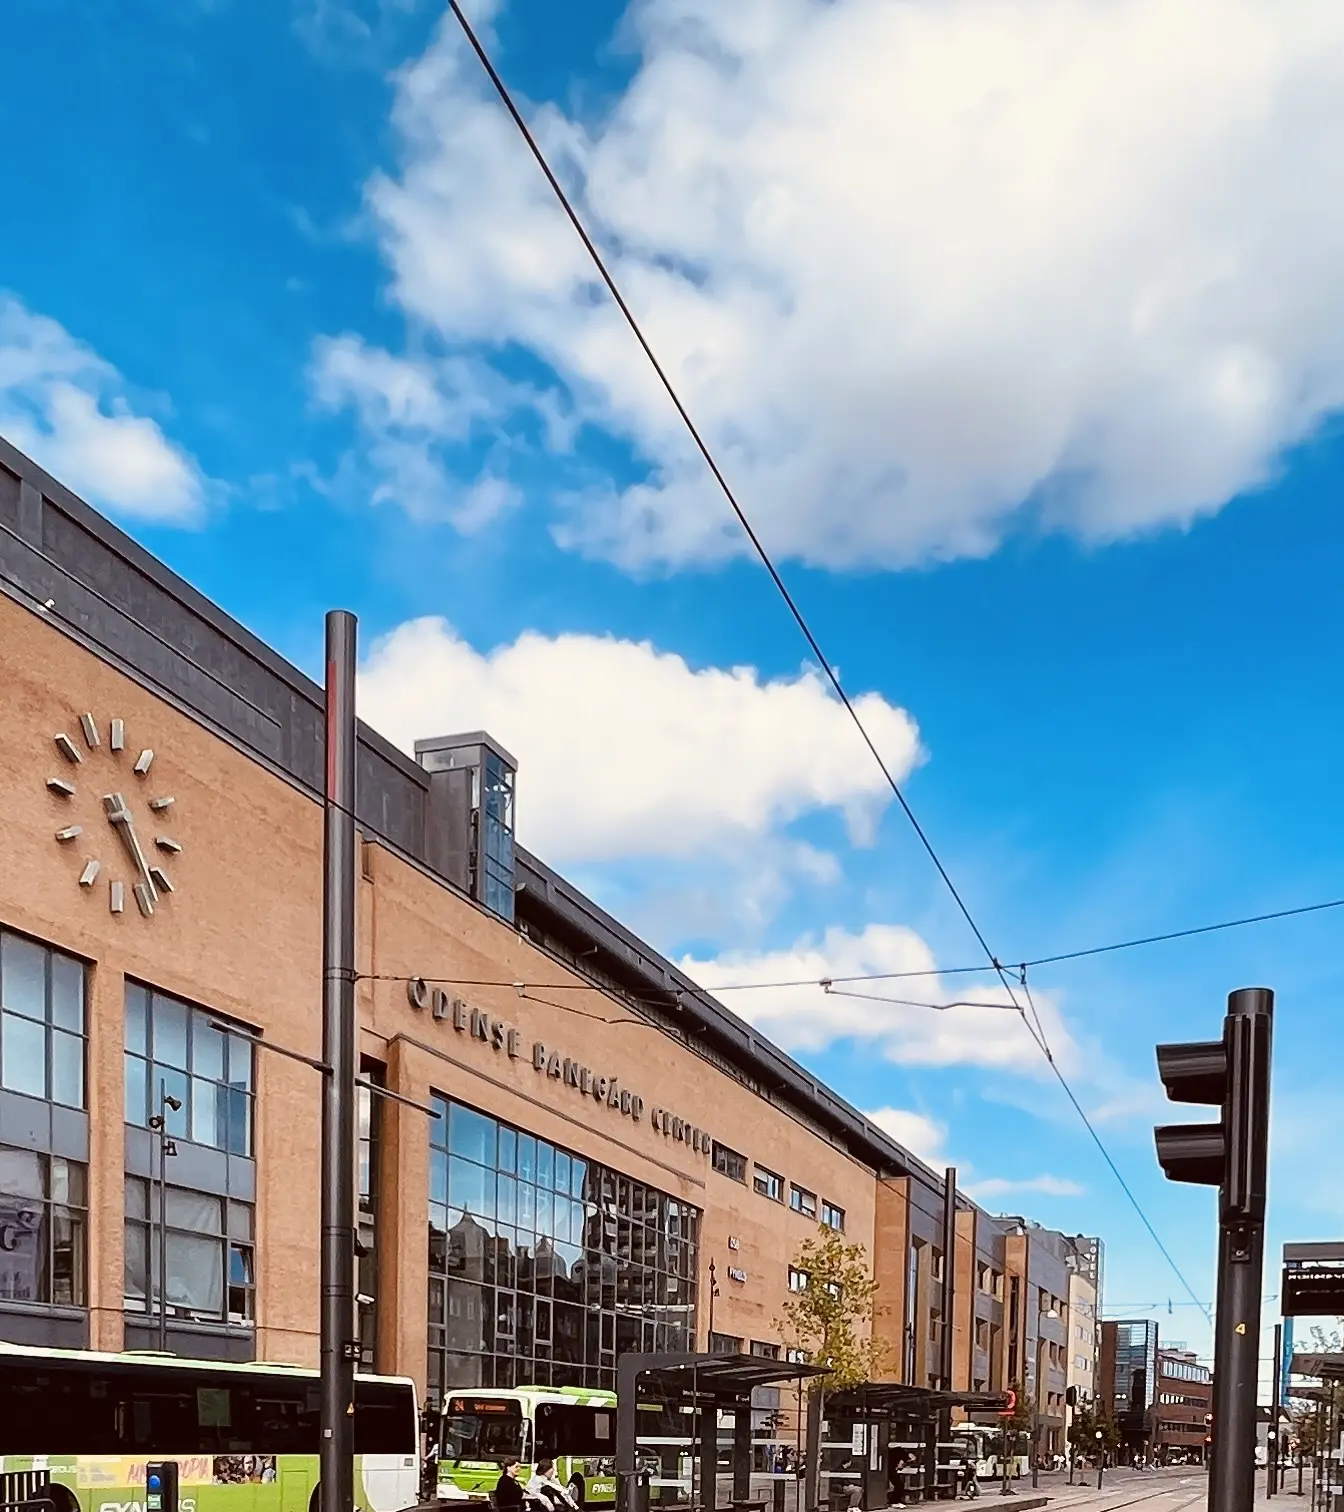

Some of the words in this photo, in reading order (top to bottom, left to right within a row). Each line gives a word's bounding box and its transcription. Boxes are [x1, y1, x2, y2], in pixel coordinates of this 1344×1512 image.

[407, 976, 521, 1058] ODENSE
[533, 1041, 644, 1122] BANEGÅRD
[1089, 1238, 1097, 1279] HOTEL
[1235, 1323, 1246, 1335] 4
